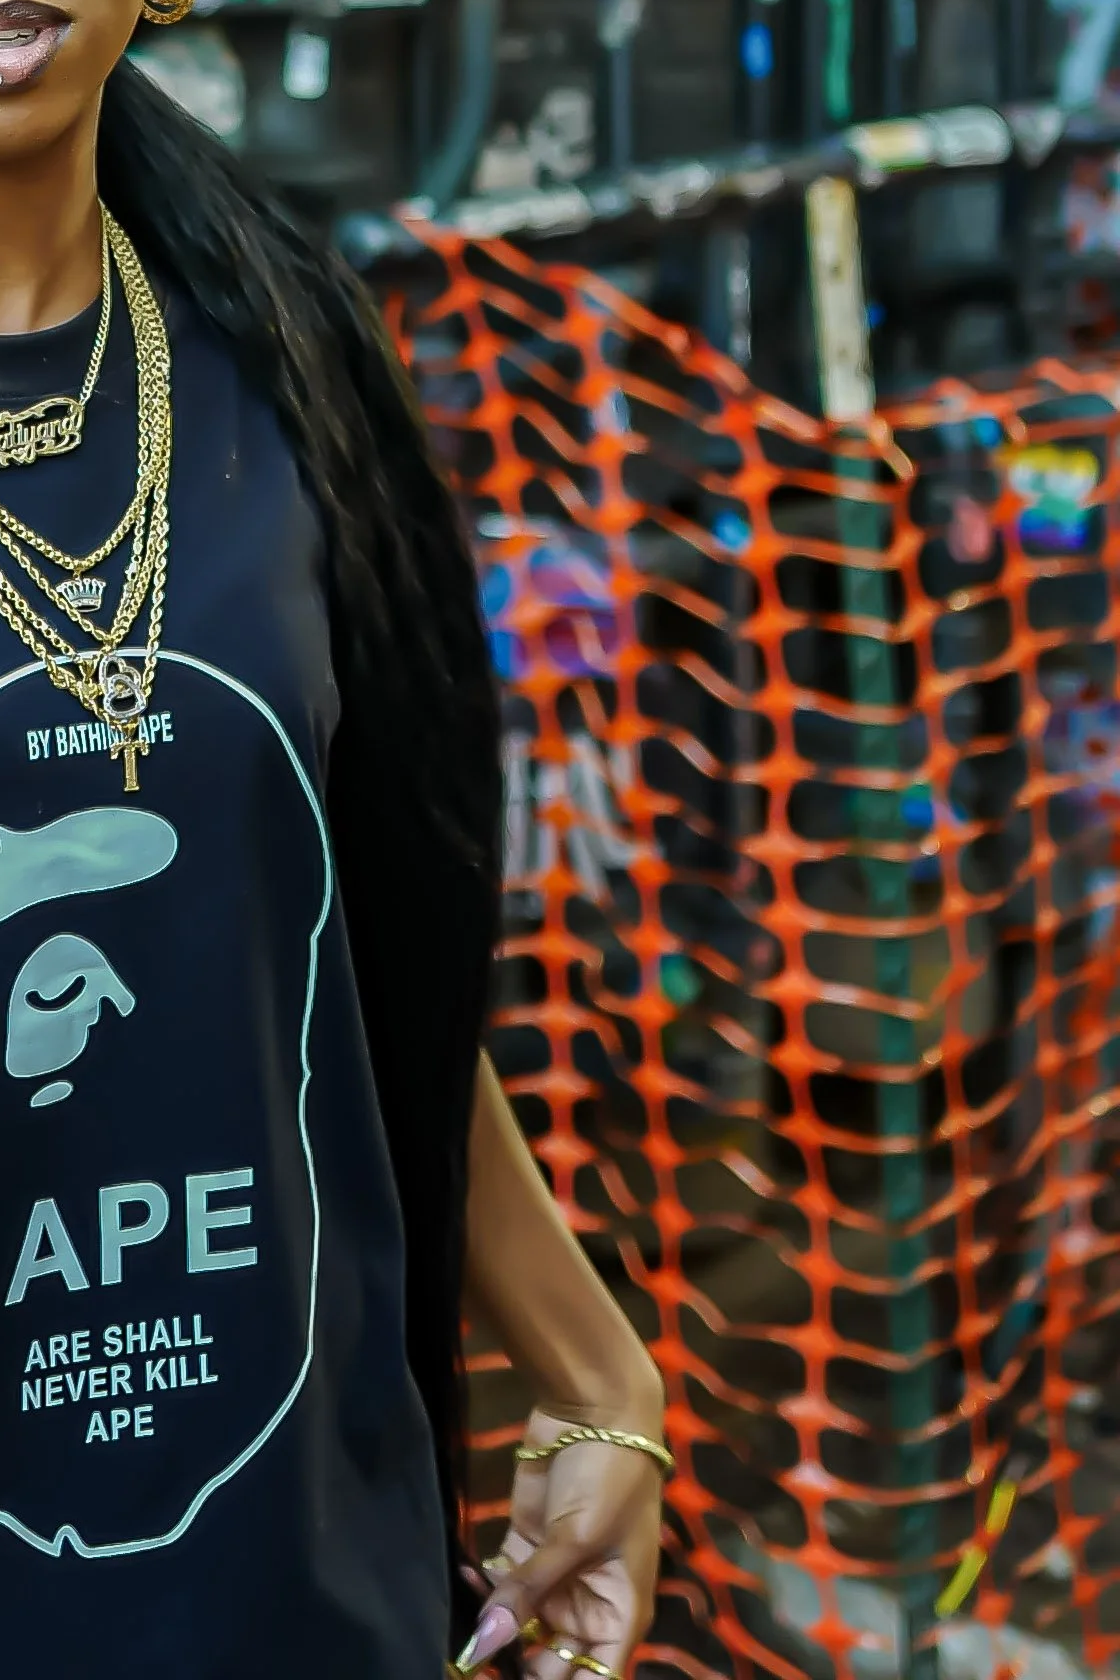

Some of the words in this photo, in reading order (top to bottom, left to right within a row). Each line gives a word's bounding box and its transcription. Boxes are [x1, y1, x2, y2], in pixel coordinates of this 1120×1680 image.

[27, 729, 50, 760] BY
[55, 720, 126, 757] BATHIN
[138, 713, 174, 745] APE
[4, 1167, 258, 1306] APE
[24, 1330, 91, 1373] ARE
[102, 1314, 214, 1357] SHALL
[21, 1363, 133, 1411] NEVER
[145, 1353, 219, 1391] KILL
[85, 1404, 154, 1443] APE
